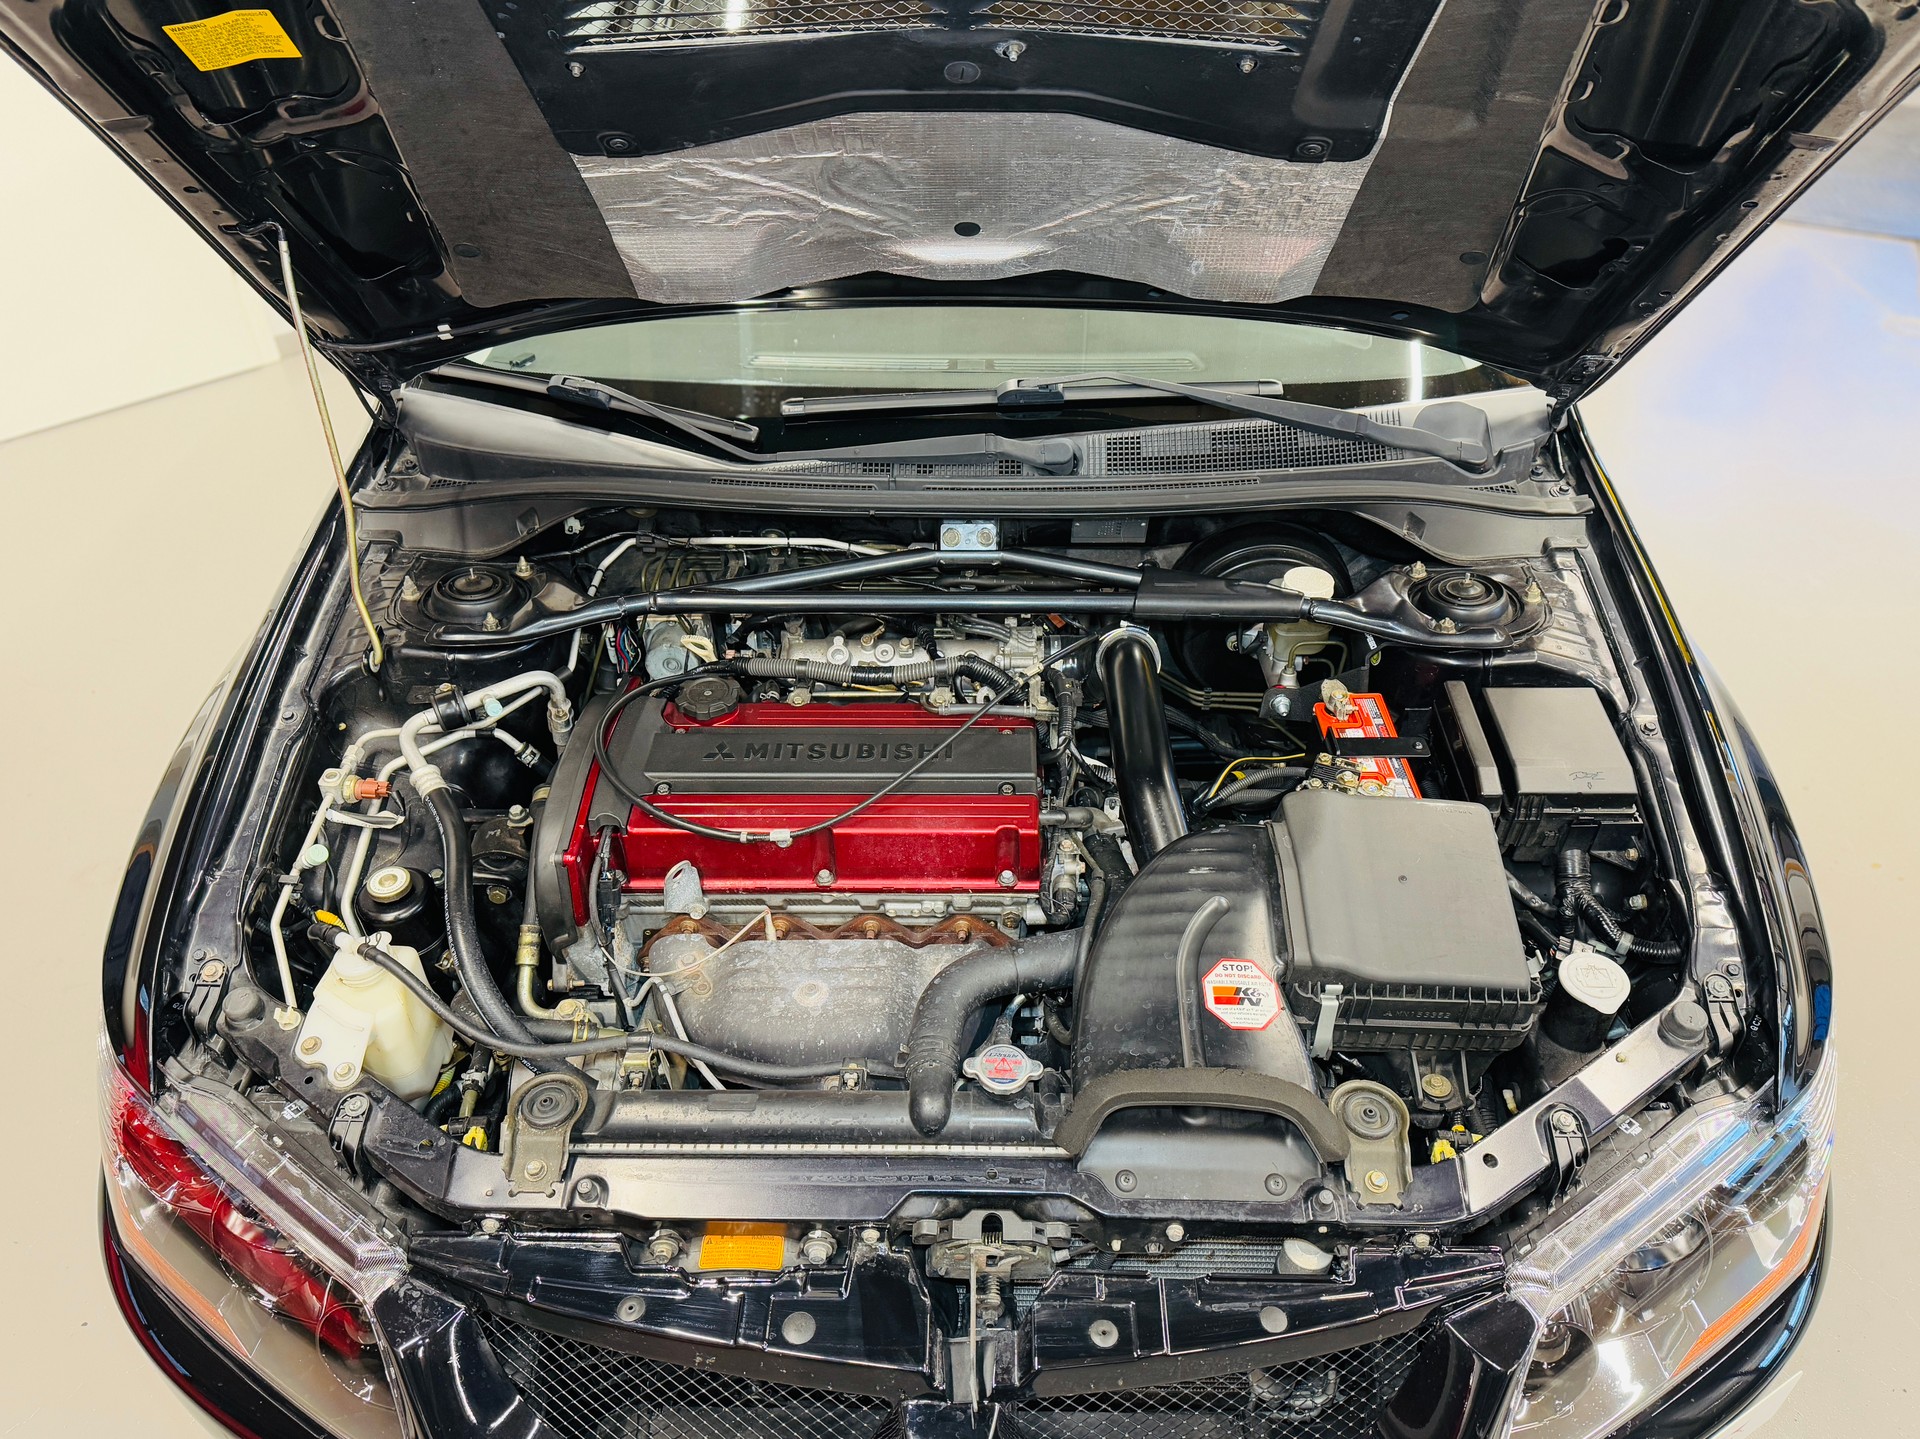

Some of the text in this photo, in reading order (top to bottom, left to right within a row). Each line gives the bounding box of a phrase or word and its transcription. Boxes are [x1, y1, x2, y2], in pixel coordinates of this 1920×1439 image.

[169, 23, 207, 33] WARNING
[743, 742, 953, 762] MITSUBISHI
[1222, 964, 1253, 972] STOP!
